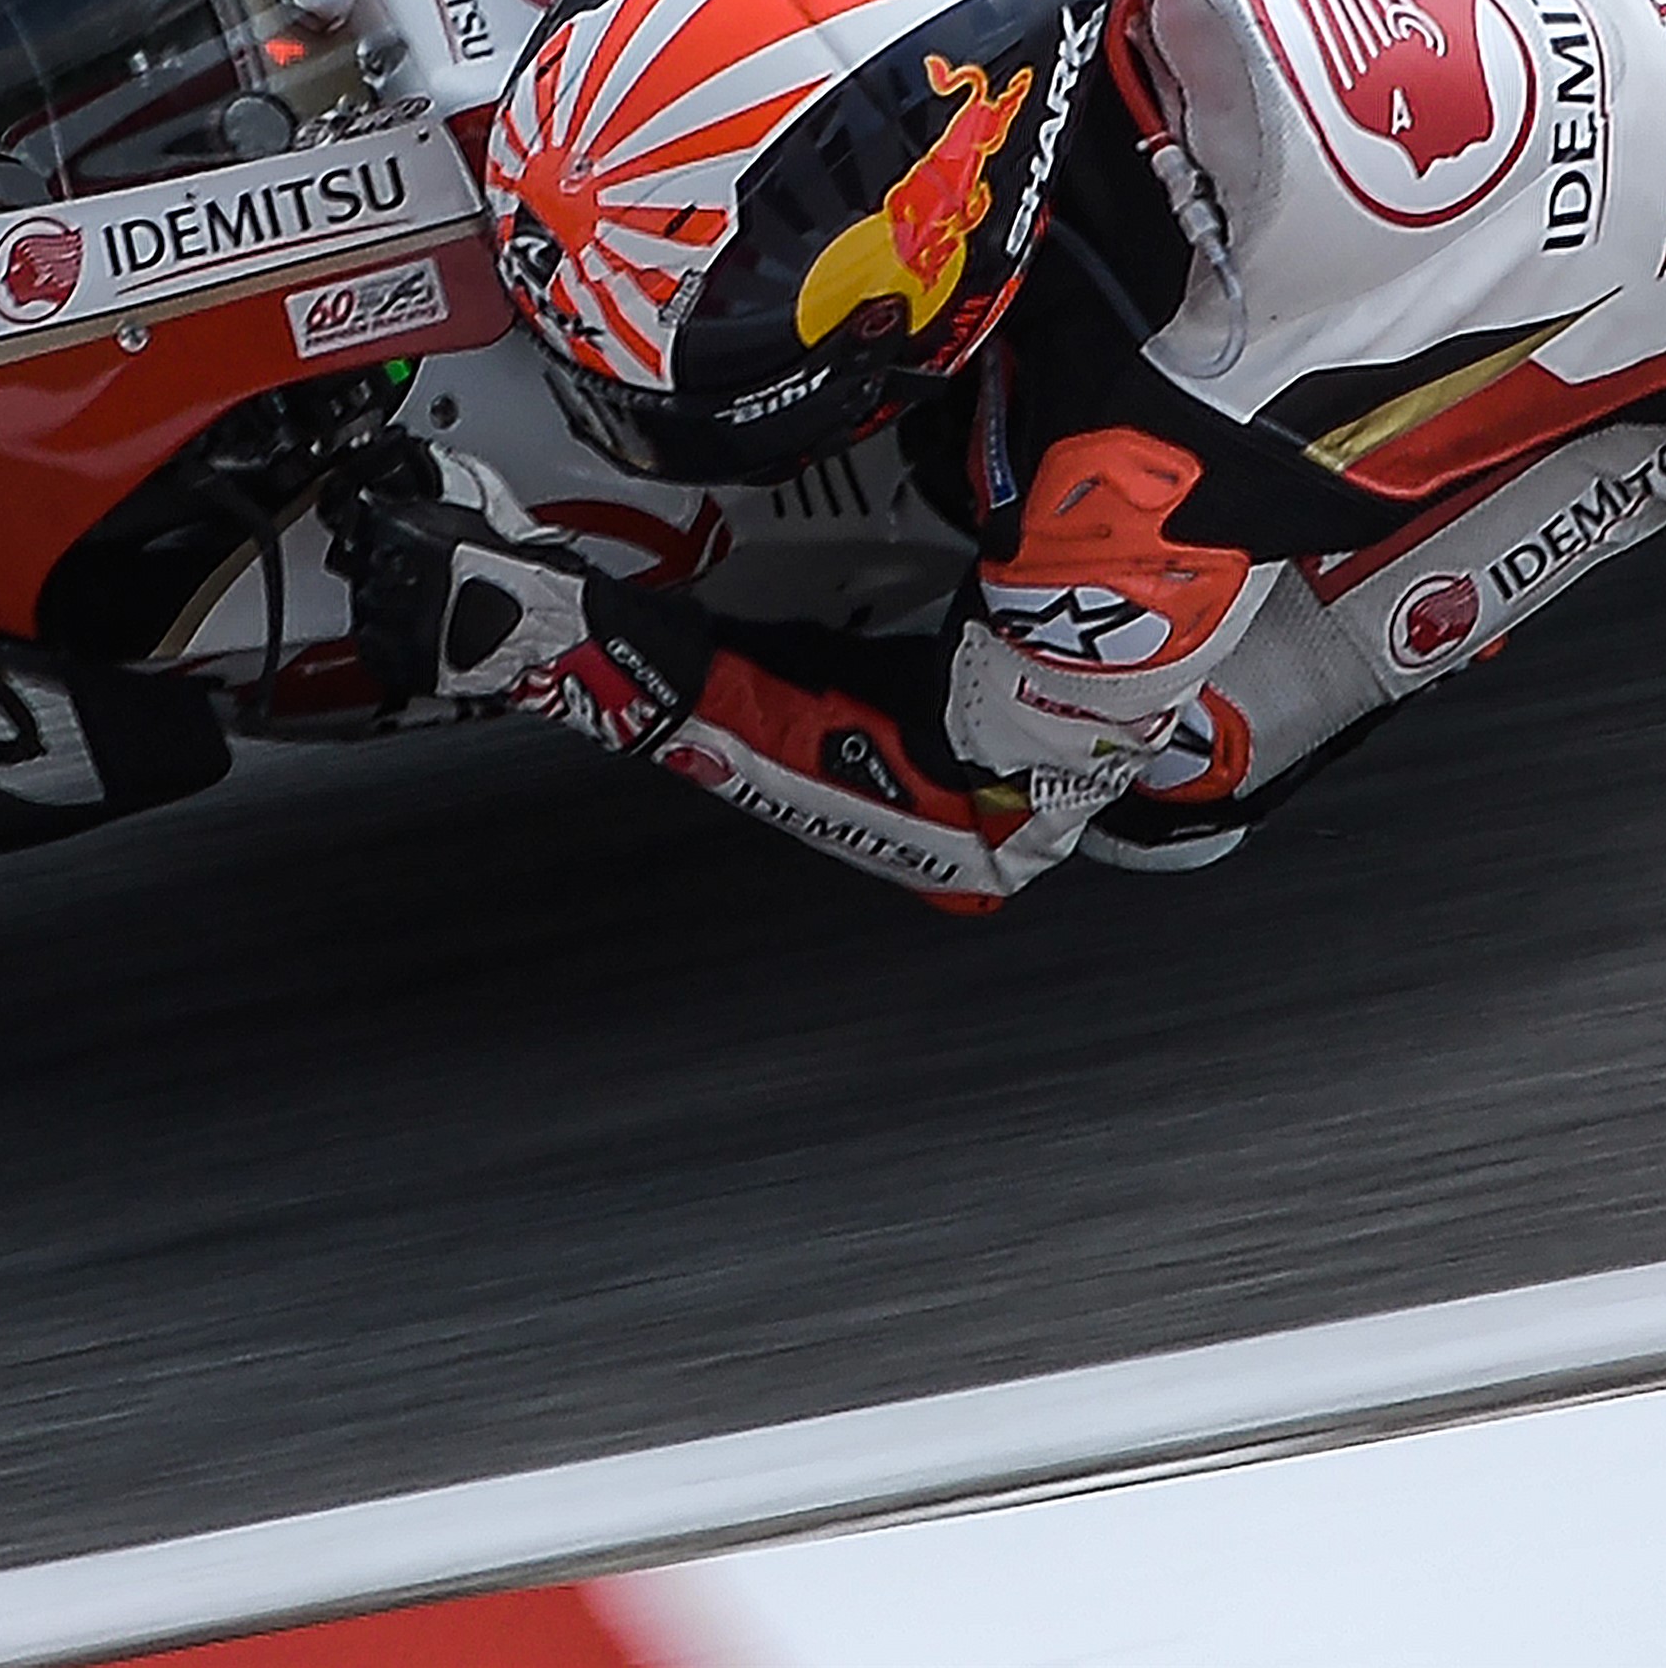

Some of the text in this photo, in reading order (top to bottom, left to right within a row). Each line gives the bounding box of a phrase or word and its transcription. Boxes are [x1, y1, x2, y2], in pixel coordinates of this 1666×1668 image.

[1006, 0, 1108, 260] SHARK
[102, 157, 406, 277] IDEMITSU
[737, 779, 959, 883] IDEMITSU
